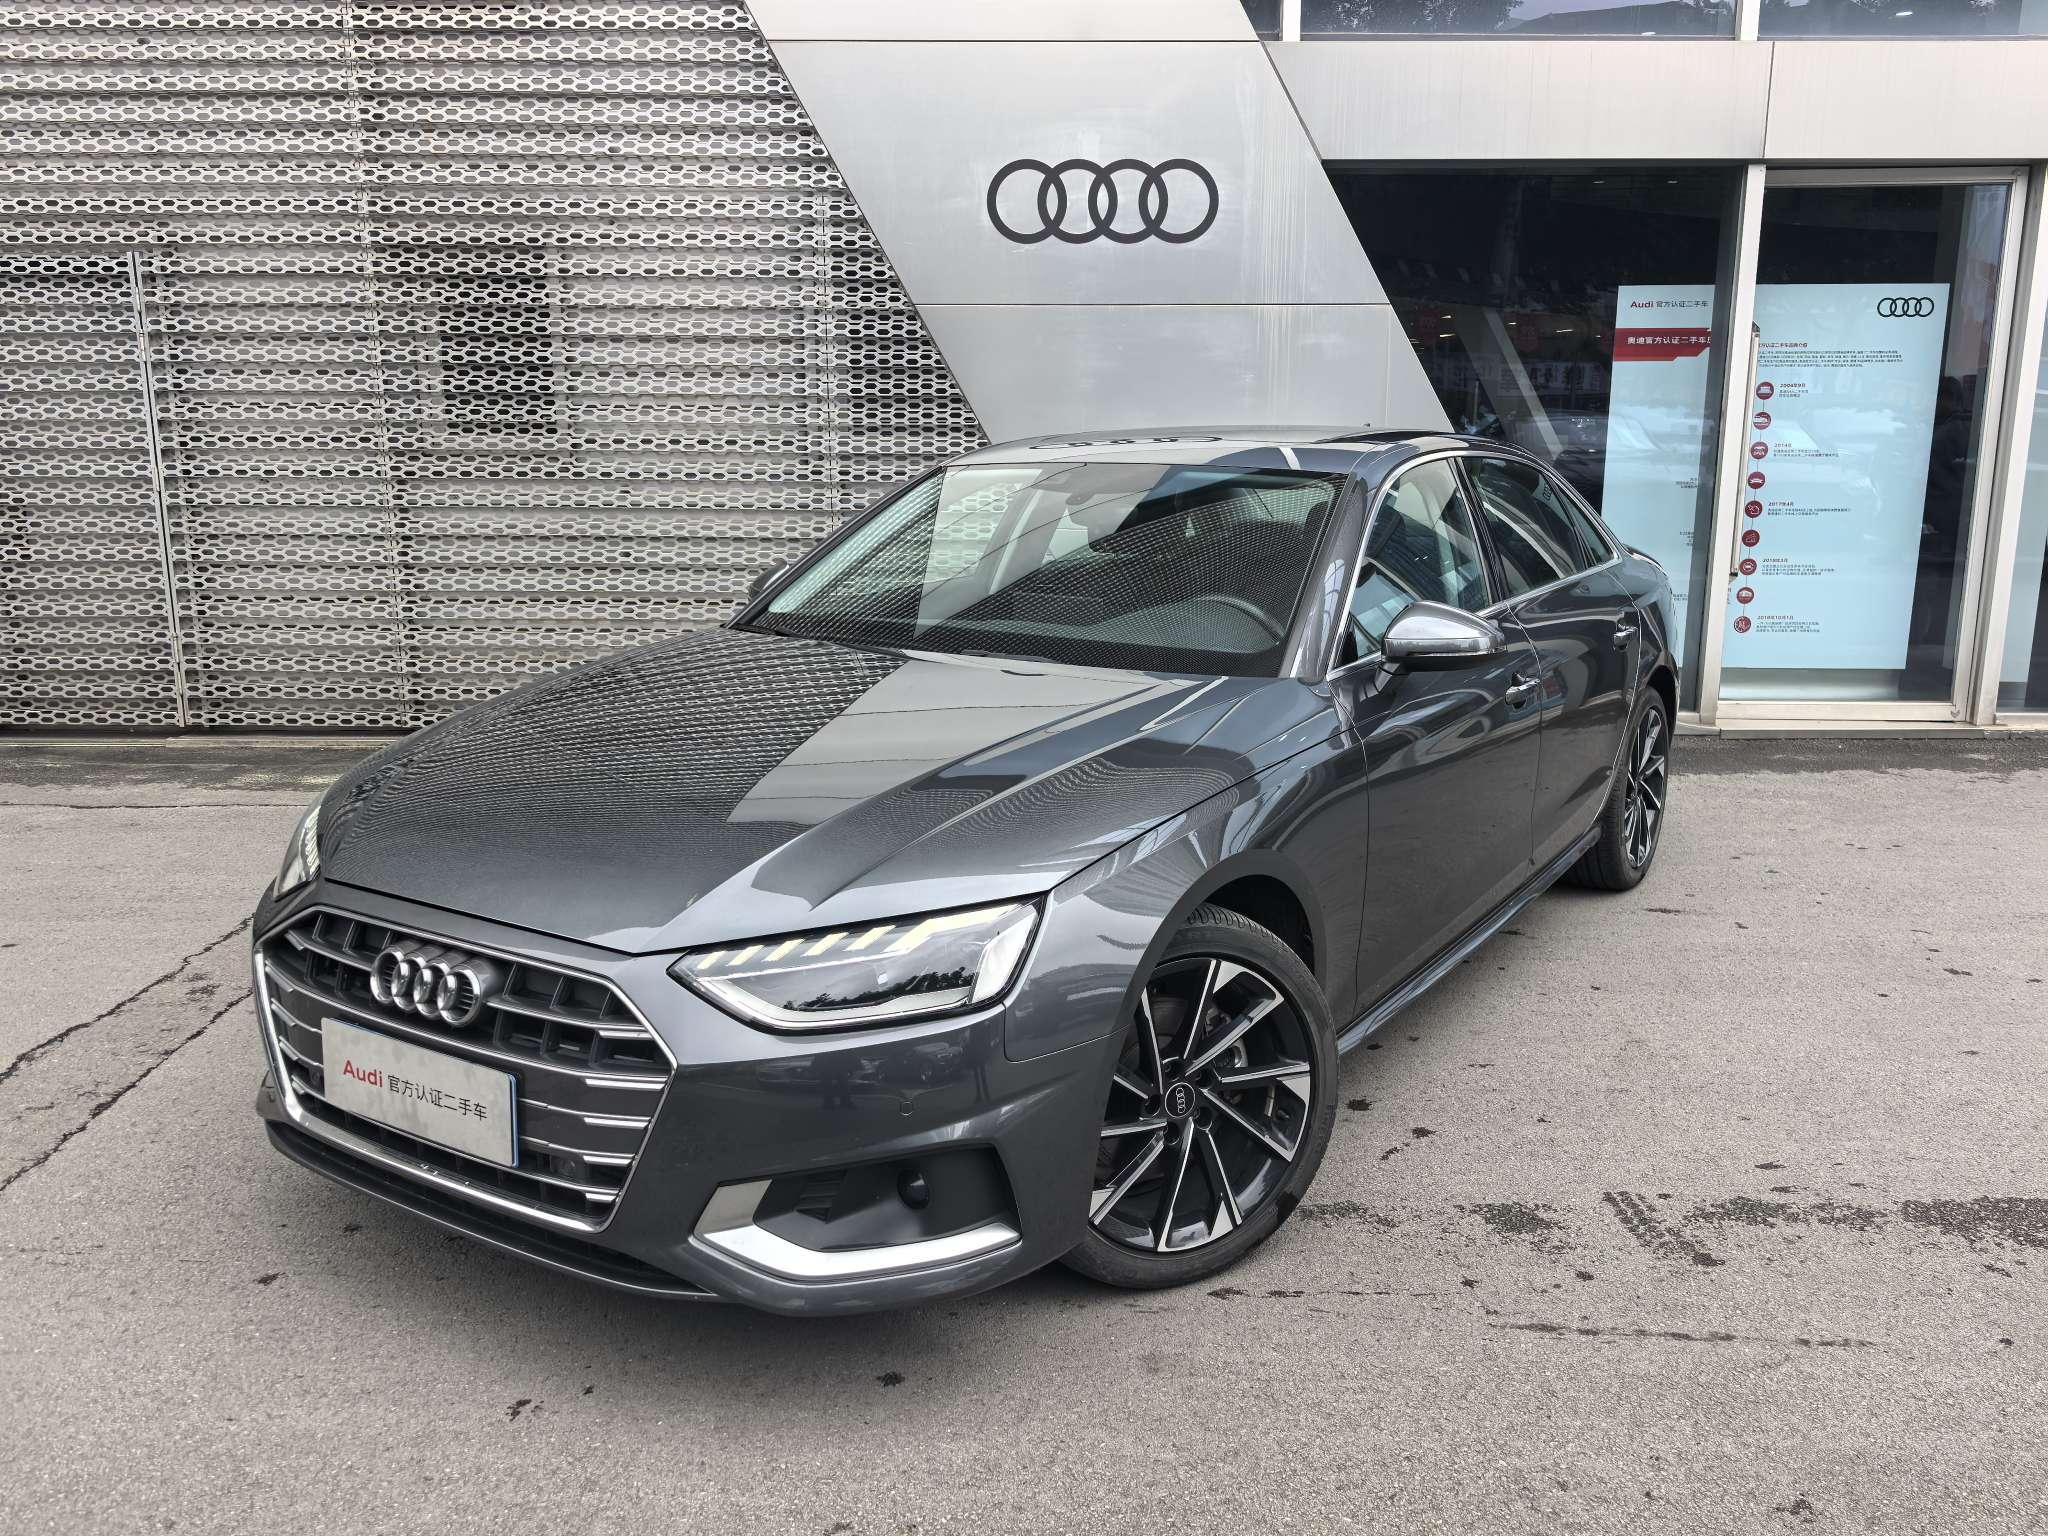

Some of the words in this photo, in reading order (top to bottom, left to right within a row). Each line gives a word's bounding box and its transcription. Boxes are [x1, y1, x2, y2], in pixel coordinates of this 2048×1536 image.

[1630, 300, 1654, 308] Audi
[1656, 300, 1709, 308] 官方认证二手车
[343, 1060, 383, 1087] Audi
[387, 1074, 488, 1122] 官方认证二手车
